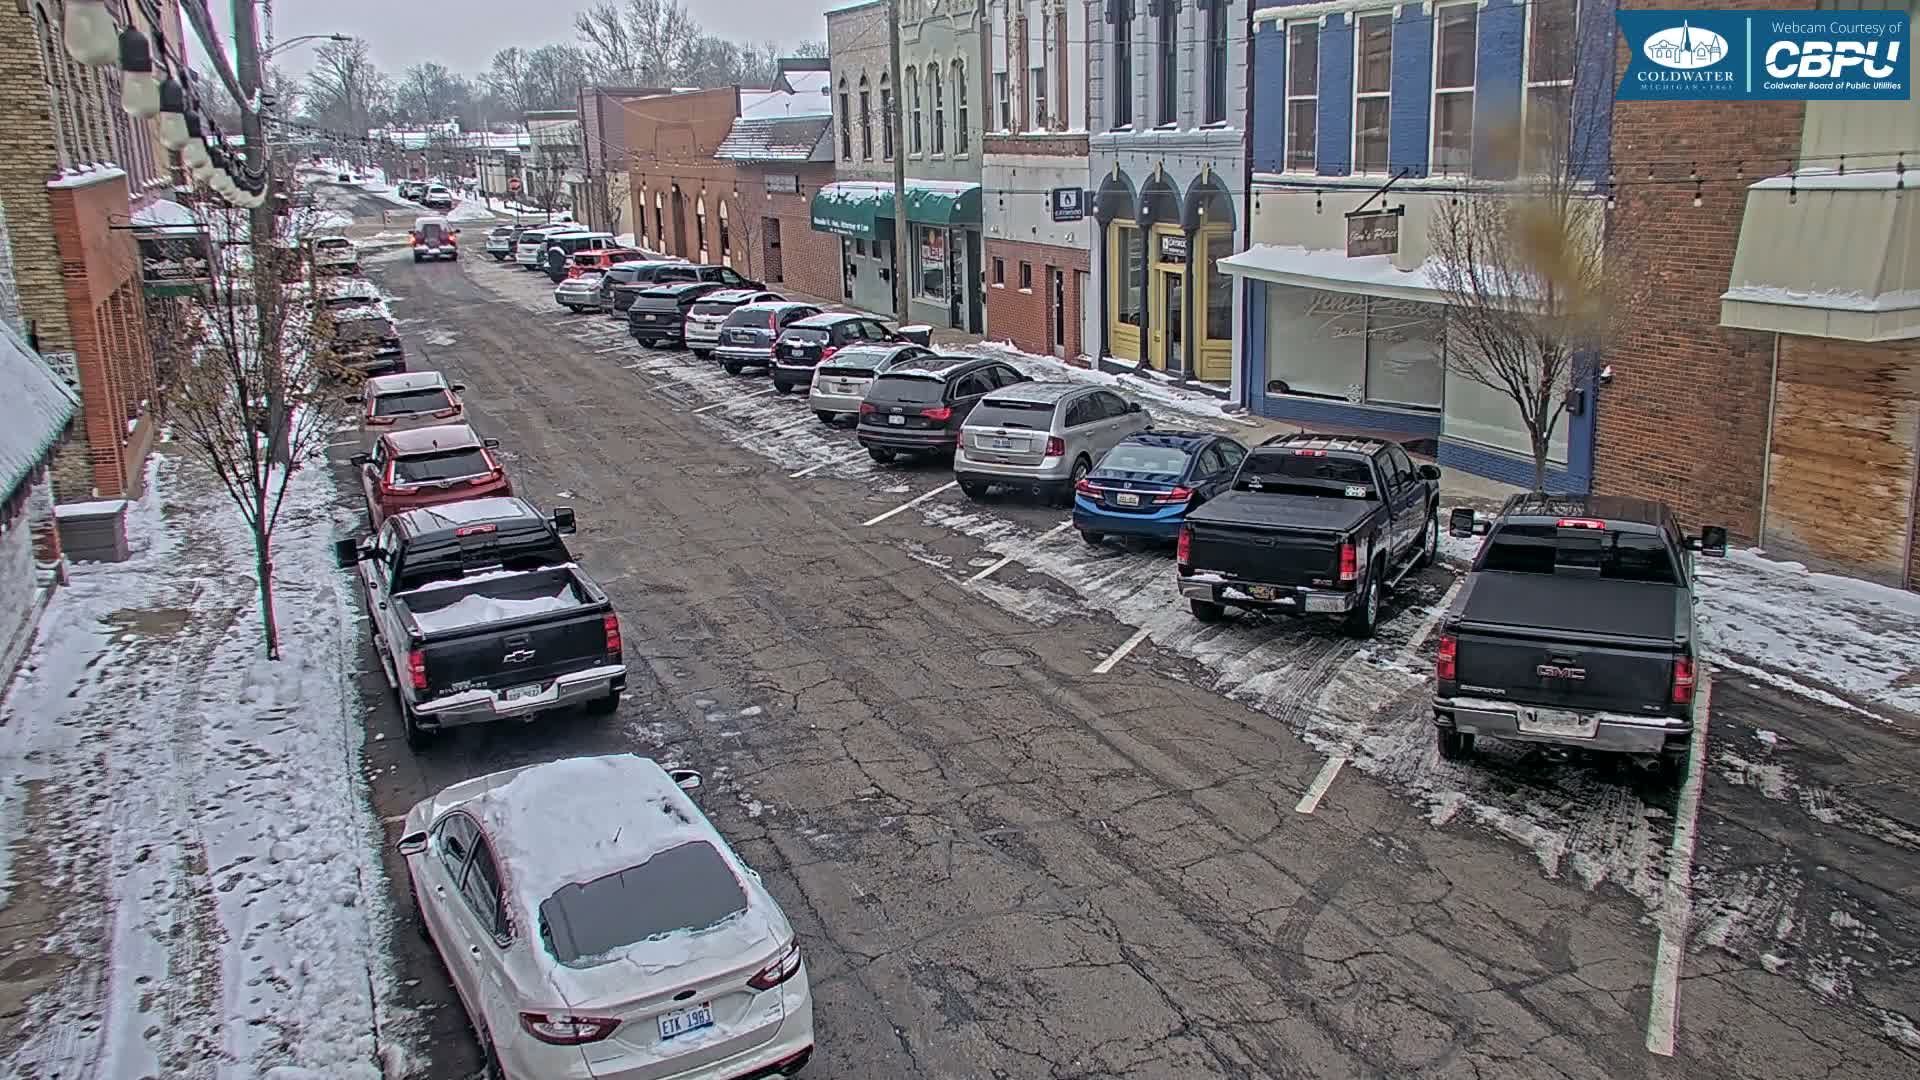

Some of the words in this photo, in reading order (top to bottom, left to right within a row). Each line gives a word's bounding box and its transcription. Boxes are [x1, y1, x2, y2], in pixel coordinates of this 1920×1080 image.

[47, 355, 73, 366] ONE
[1537, 664, 1586, 680] GMC
[686, 1009, 712, 1028] 1983
